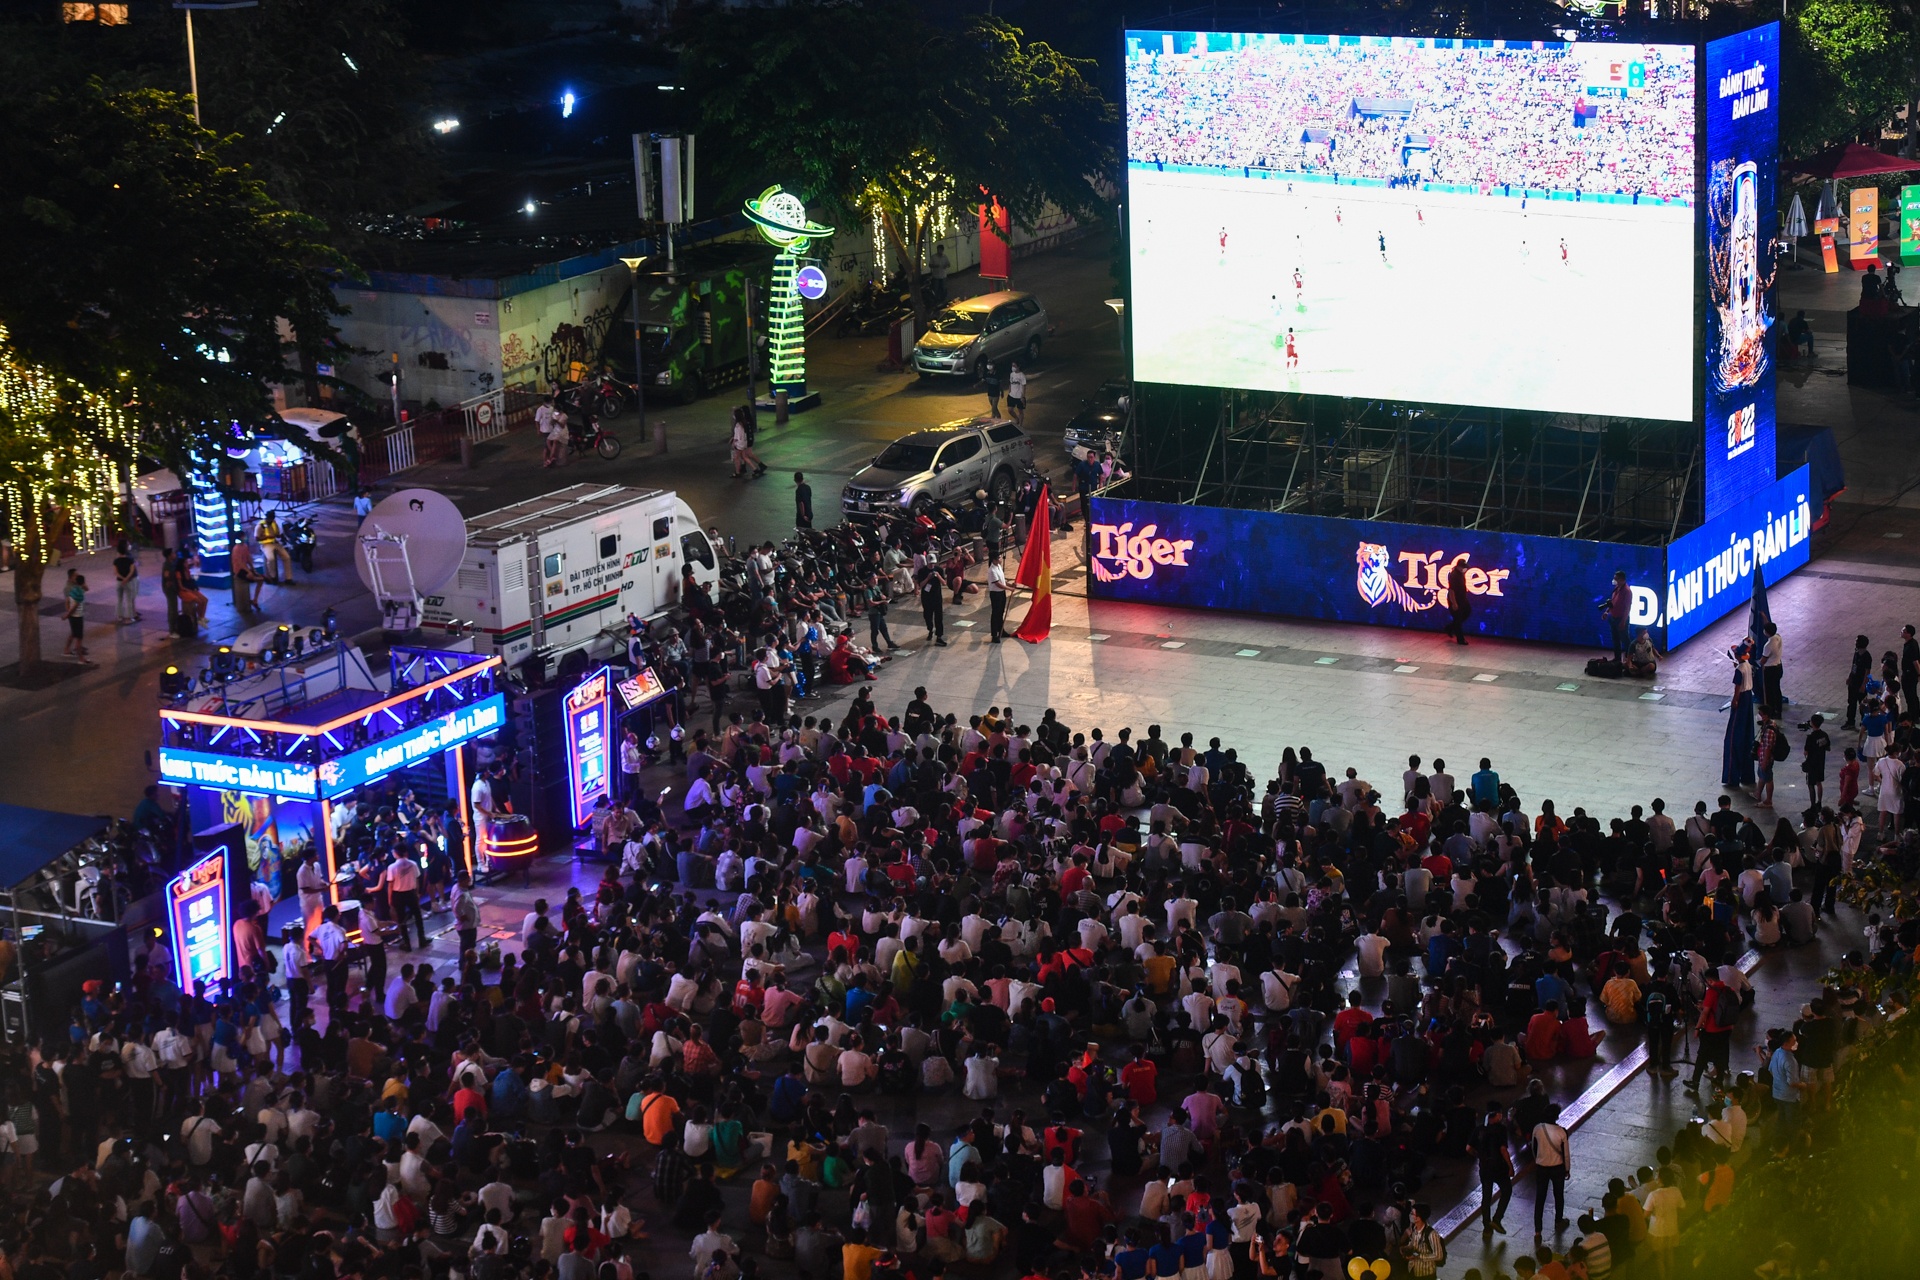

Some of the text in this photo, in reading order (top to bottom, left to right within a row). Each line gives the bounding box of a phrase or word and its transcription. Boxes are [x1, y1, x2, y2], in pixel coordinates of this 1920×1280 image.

[1719, 60, 1765, 98] ĐÁNH THỨC
[1732, 91, 1750, 120] BẢN
[623, 547, 649, 569] HTV
[1091, 522, 1194, 579] Tiger
[1705, 532, 1751, 599] THỨC
[621, 581, 634, 592] HD
